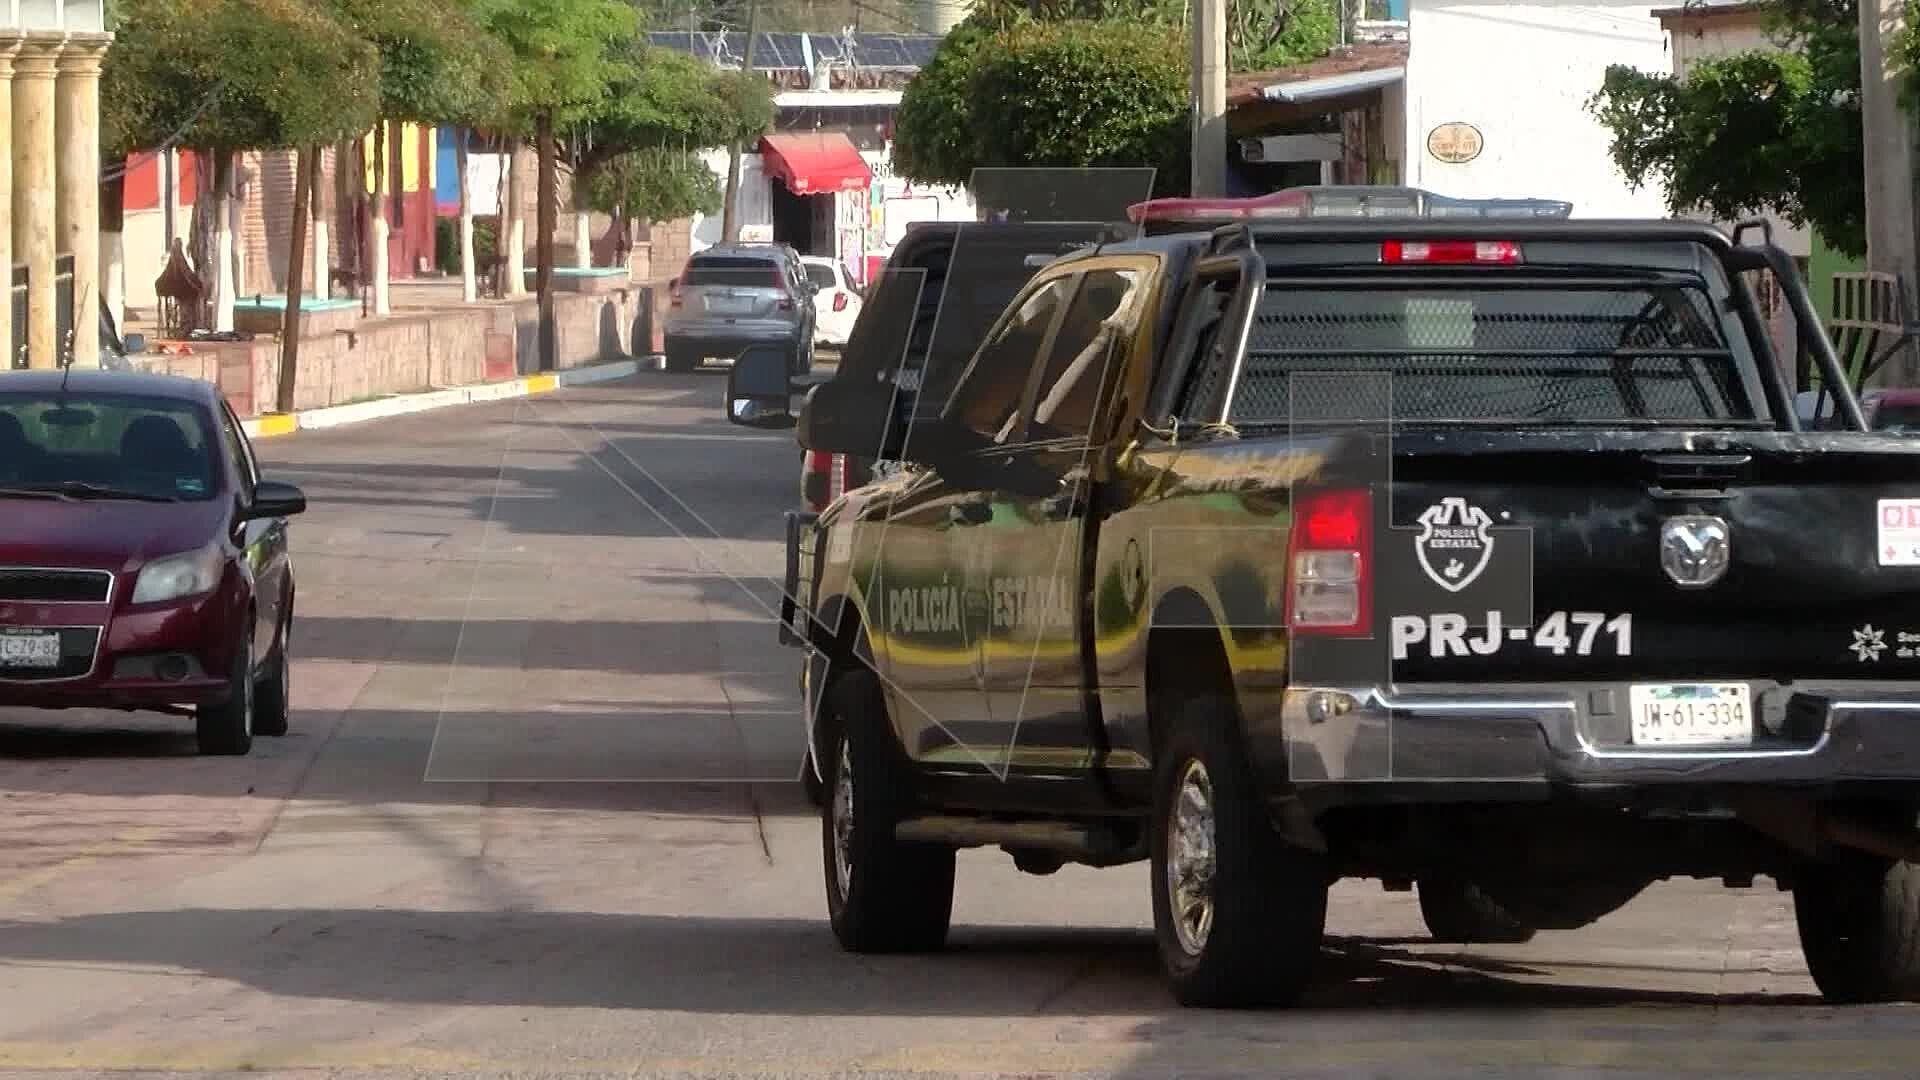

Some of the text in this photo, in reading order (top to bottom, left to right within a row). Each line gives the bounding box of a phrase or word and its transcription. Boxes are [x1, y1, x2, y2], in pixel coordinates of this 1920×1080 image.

[889, 571, 961, 633] POLICÍA
[1391, 610, 1633, 661] PRJ-471
[1640, 702, 1744, 727] JW-61-334
